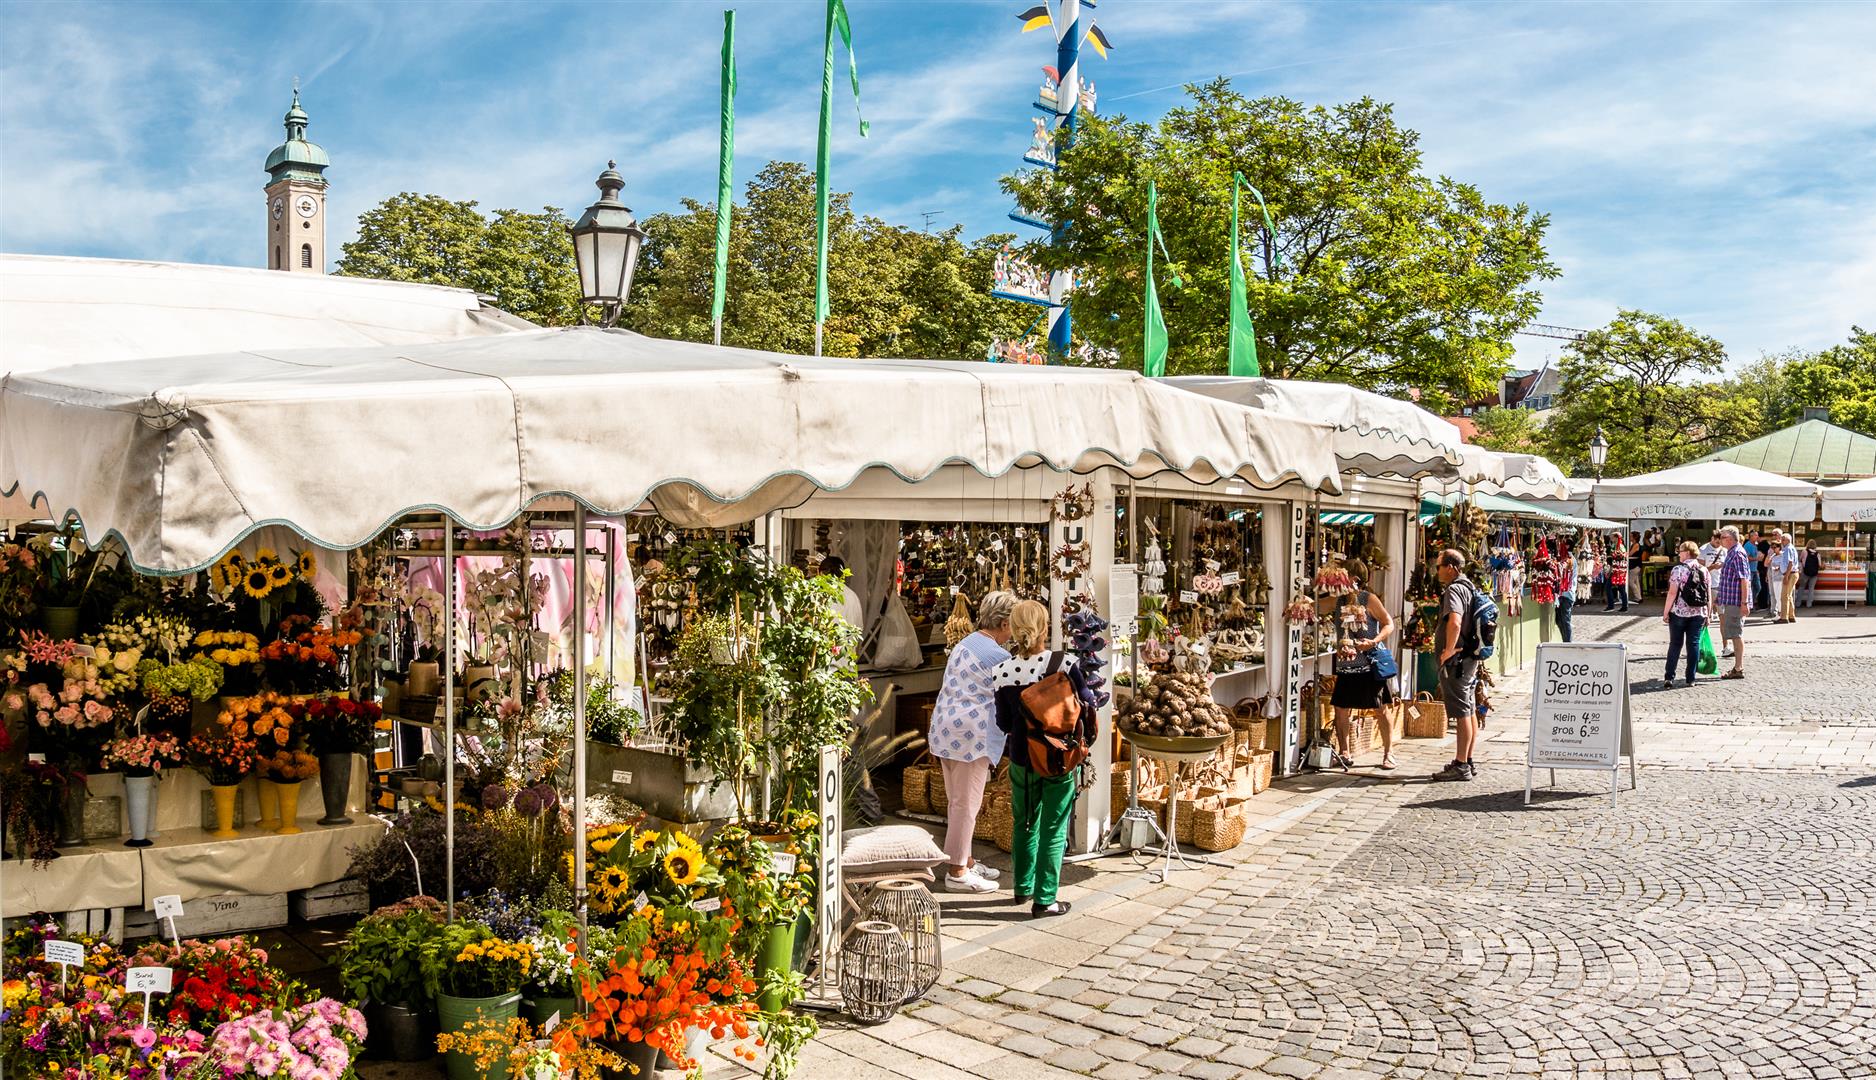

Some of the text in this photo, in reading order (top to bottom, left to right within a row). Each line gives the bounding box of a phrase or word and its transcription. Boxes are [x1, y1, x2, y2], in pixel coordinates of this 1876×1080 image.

[1722, 507, 1776, 517] SAFTBAR
[1545, 660, 1609, 678] Rose von
[1545, 679, 1613, 697] Jericho
[1551, 726, 1575, 735] groß
[825, 769, 836, 936] OPEN
[212, 900, 239, 912] Vino
